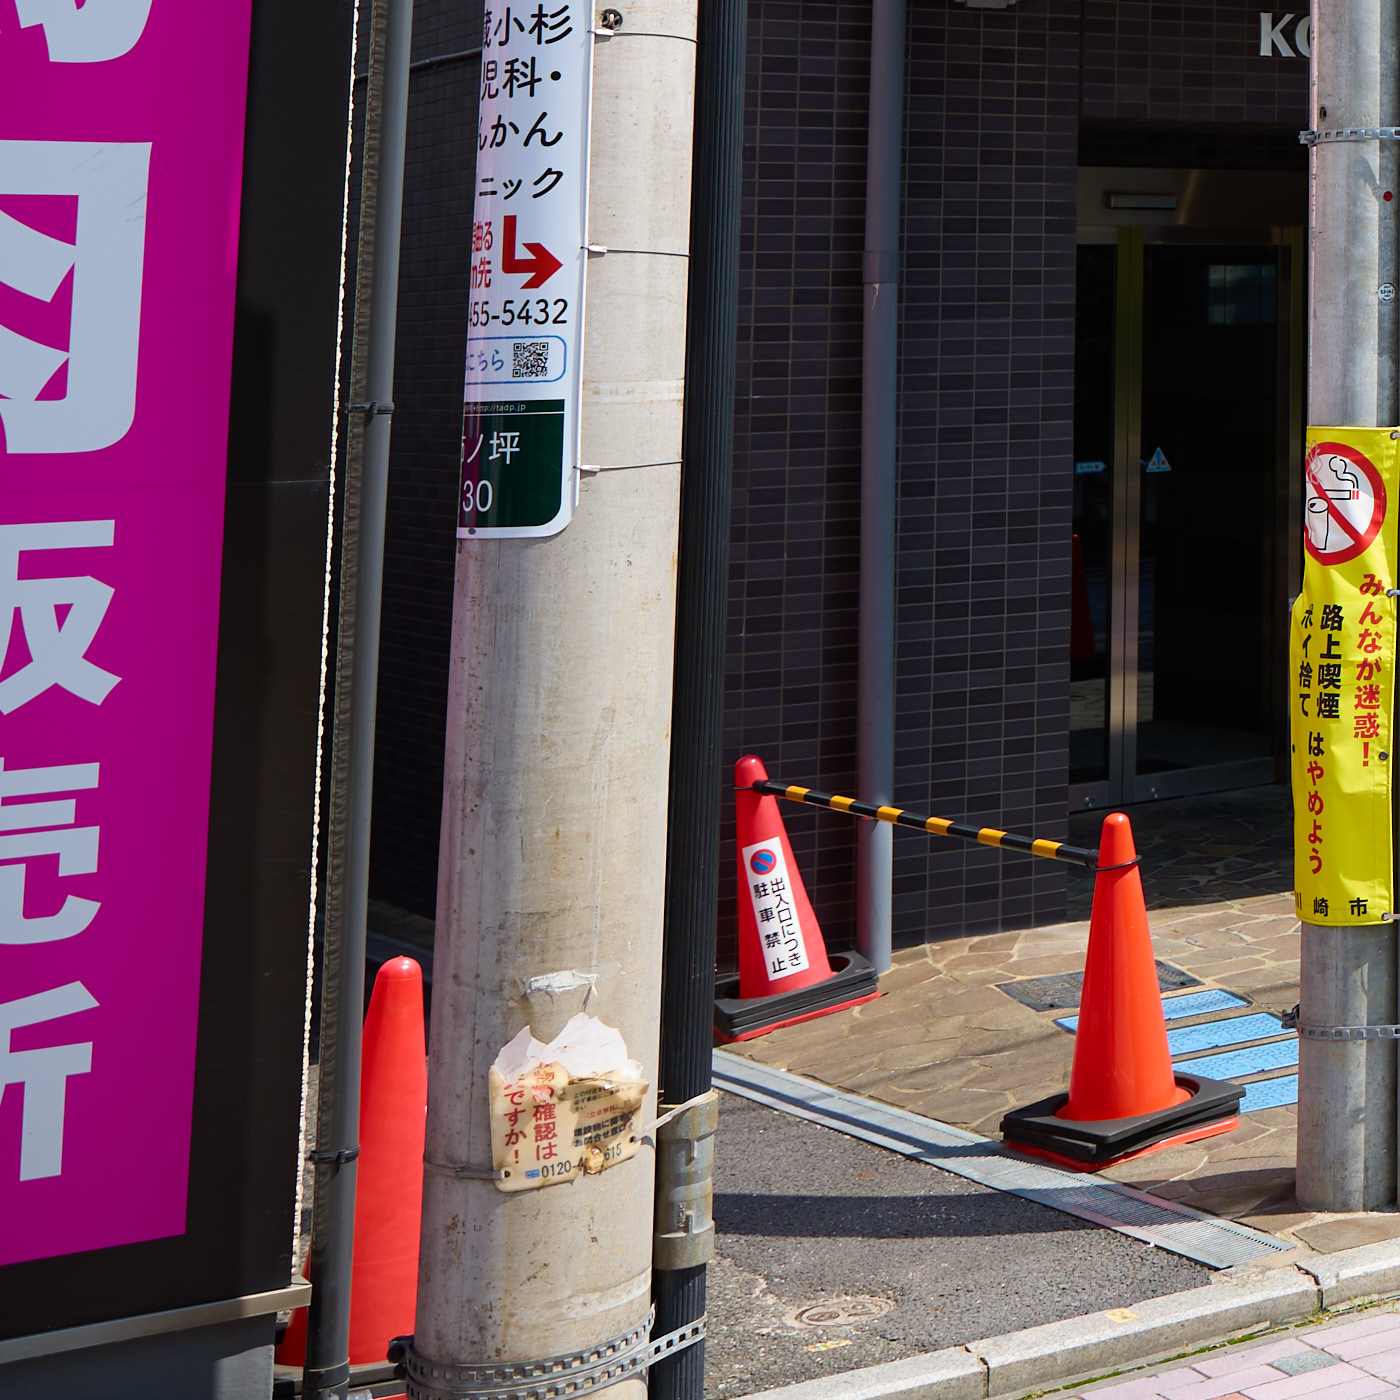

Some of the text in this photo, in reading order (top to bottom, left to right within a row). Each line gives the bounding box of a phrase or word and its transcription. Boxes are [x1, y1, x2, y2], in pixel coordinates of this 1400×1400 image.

[466, 348, 505, 372] こちら
[1297, 603, 1315, 719] ポイ捨て
[1316, 604, 1344, 719] 路上喫煙
[1353, 573, 1387, 768] みんなが迷惑！
[1306, 731, 1326, 876] はやめよう
[753, 881, 786, 974] 駐車禁止
[769, 876, 802, 968] 出入口につき
[541, 1142, 623, 1179] 0120-4615
